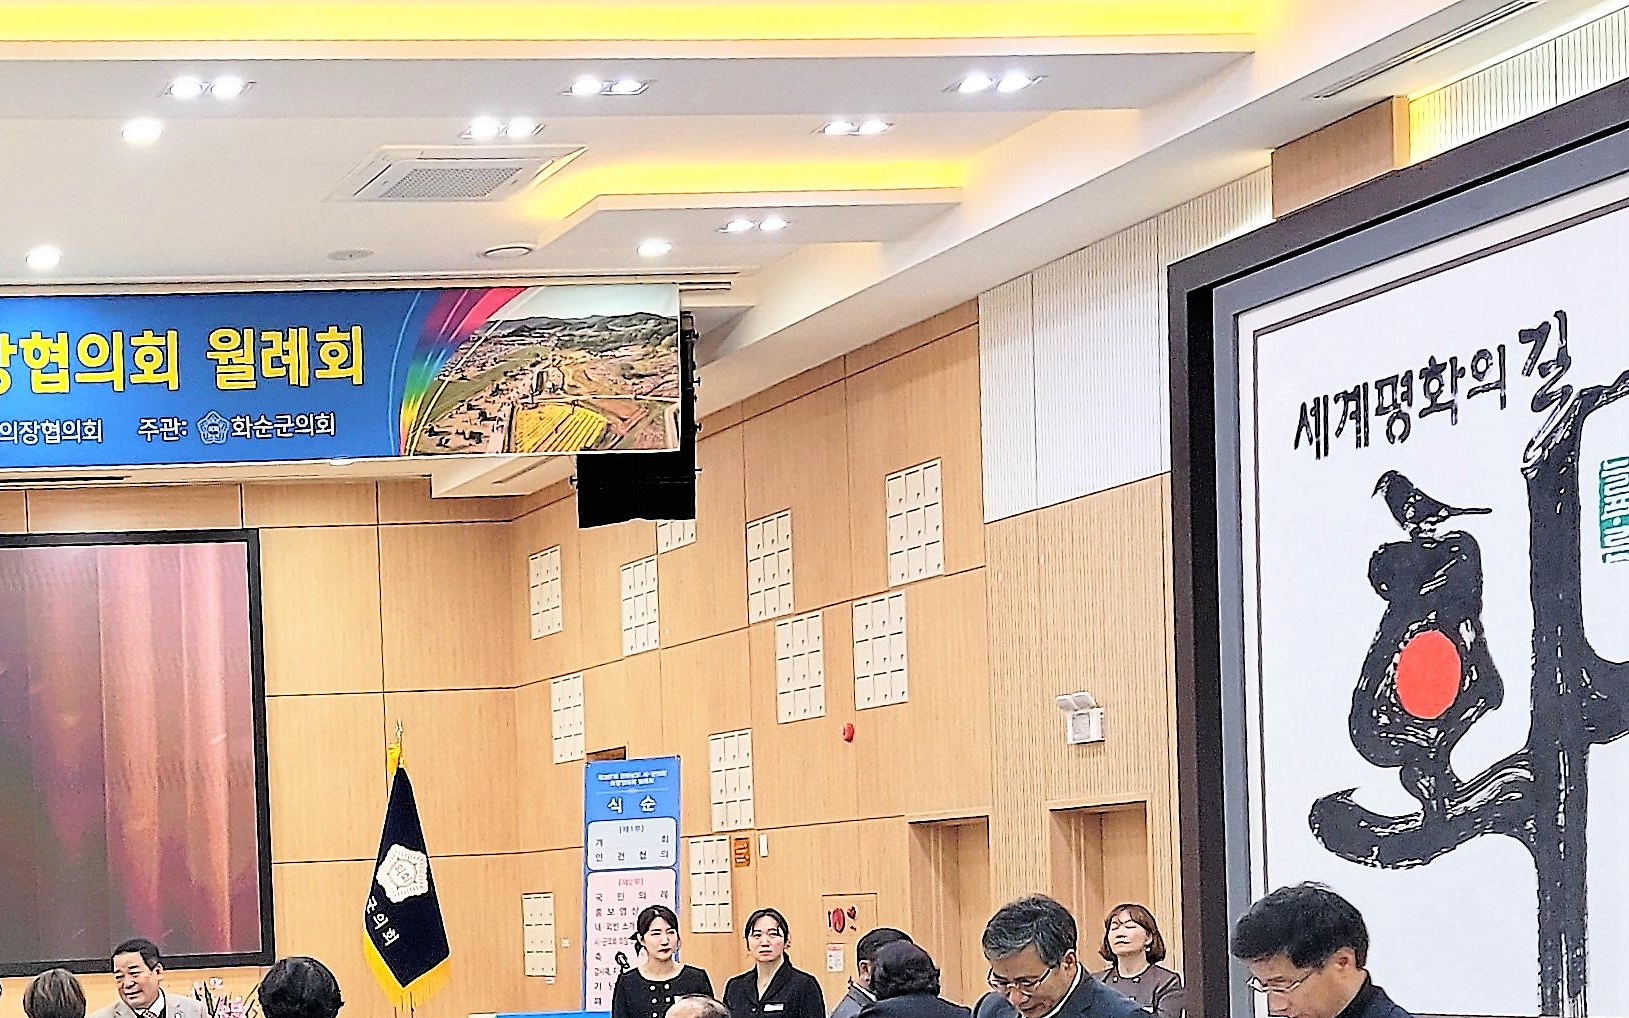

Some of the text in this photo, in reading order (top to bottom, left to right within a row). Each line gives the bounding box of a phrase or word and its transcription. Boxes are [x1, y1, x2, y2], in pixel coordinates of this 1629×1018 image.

[202, 322, 366, 390] 월례회
[137, 414, 189, 443] 주관:
[230, 410, 337, 440] 화순군의회
